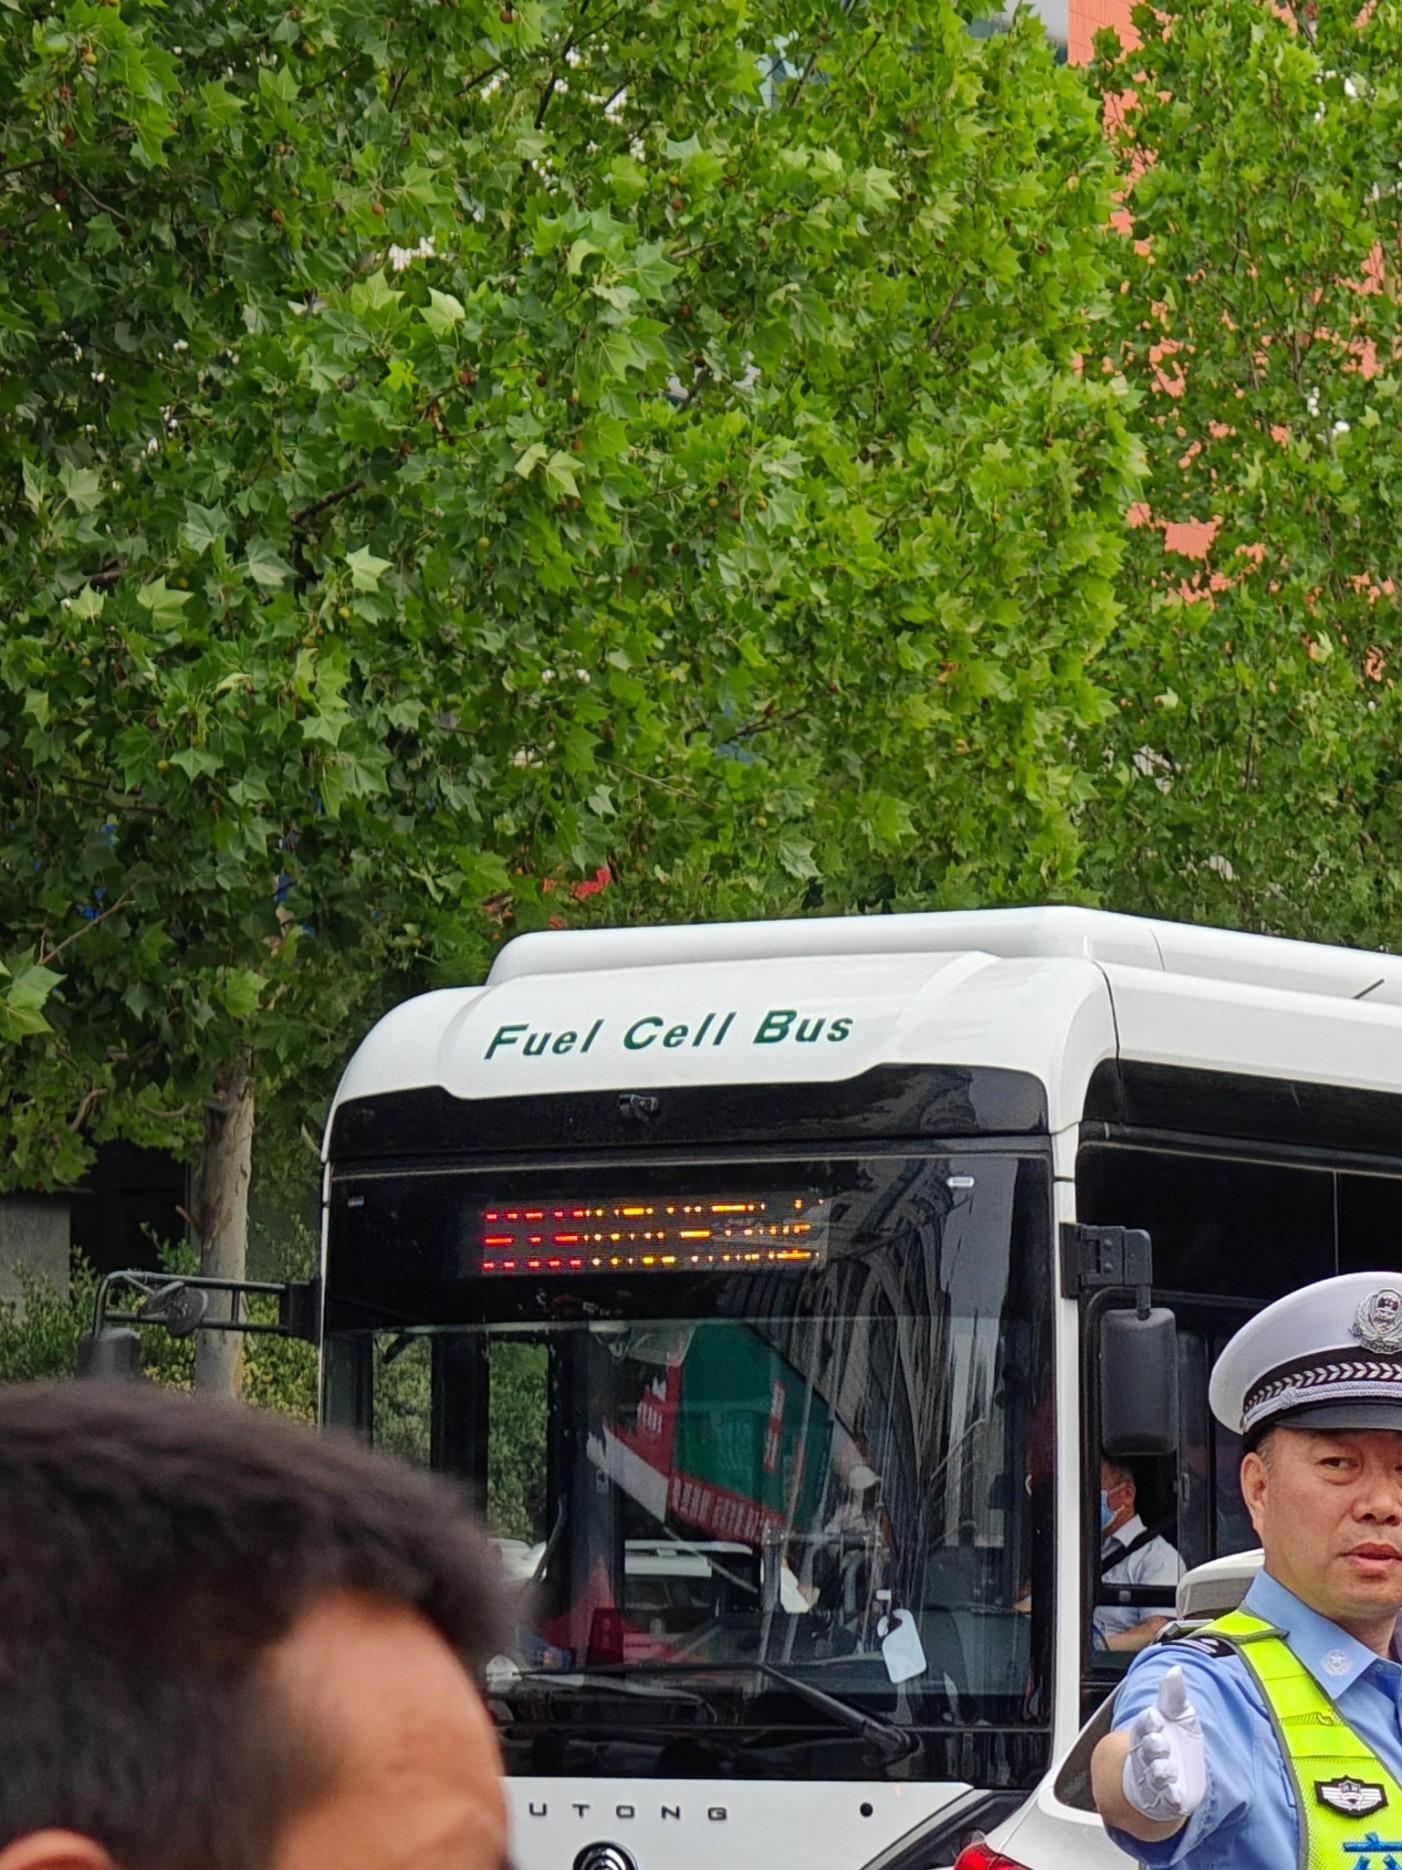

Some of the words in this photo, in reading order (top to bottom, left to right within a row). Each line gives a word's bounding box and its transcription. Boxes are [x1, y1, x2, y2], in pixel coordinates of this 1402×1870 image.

[484, 1018, 604, 1060] Fuel
[622, 1011, 737, 1050] Cell
[752, 1009, 854, 1044] Bus
[528, 1802, 728, 1822] UTONG
